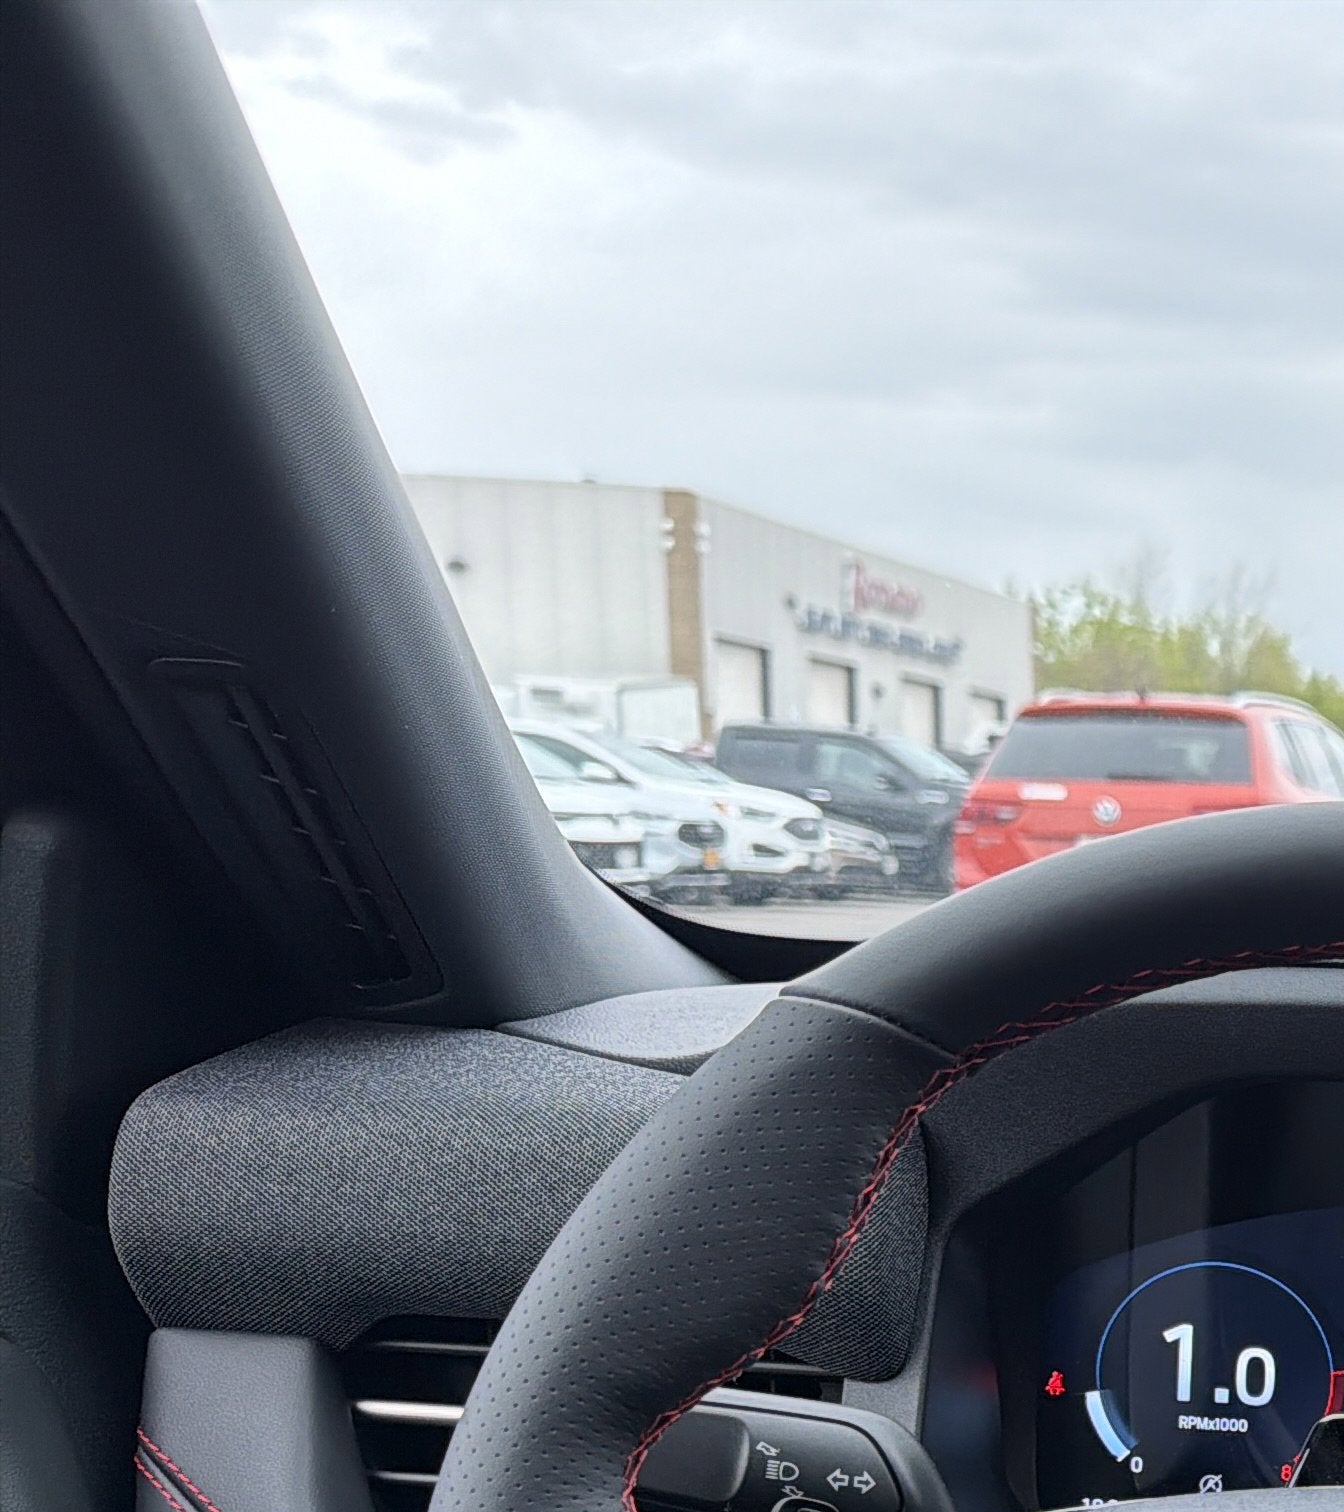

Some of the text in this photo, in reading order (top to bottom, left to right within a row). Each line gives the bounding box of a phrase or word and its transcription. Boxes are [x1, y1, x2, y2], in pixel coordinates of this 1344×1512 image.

[1162, 1323, 1276, 1407] 1.0
[1178, 1415, 1248, 1433] RPMx1000
[1130, 1456, 1143, 1473] 0
[1280, 1464, 1292, 1482] 8
